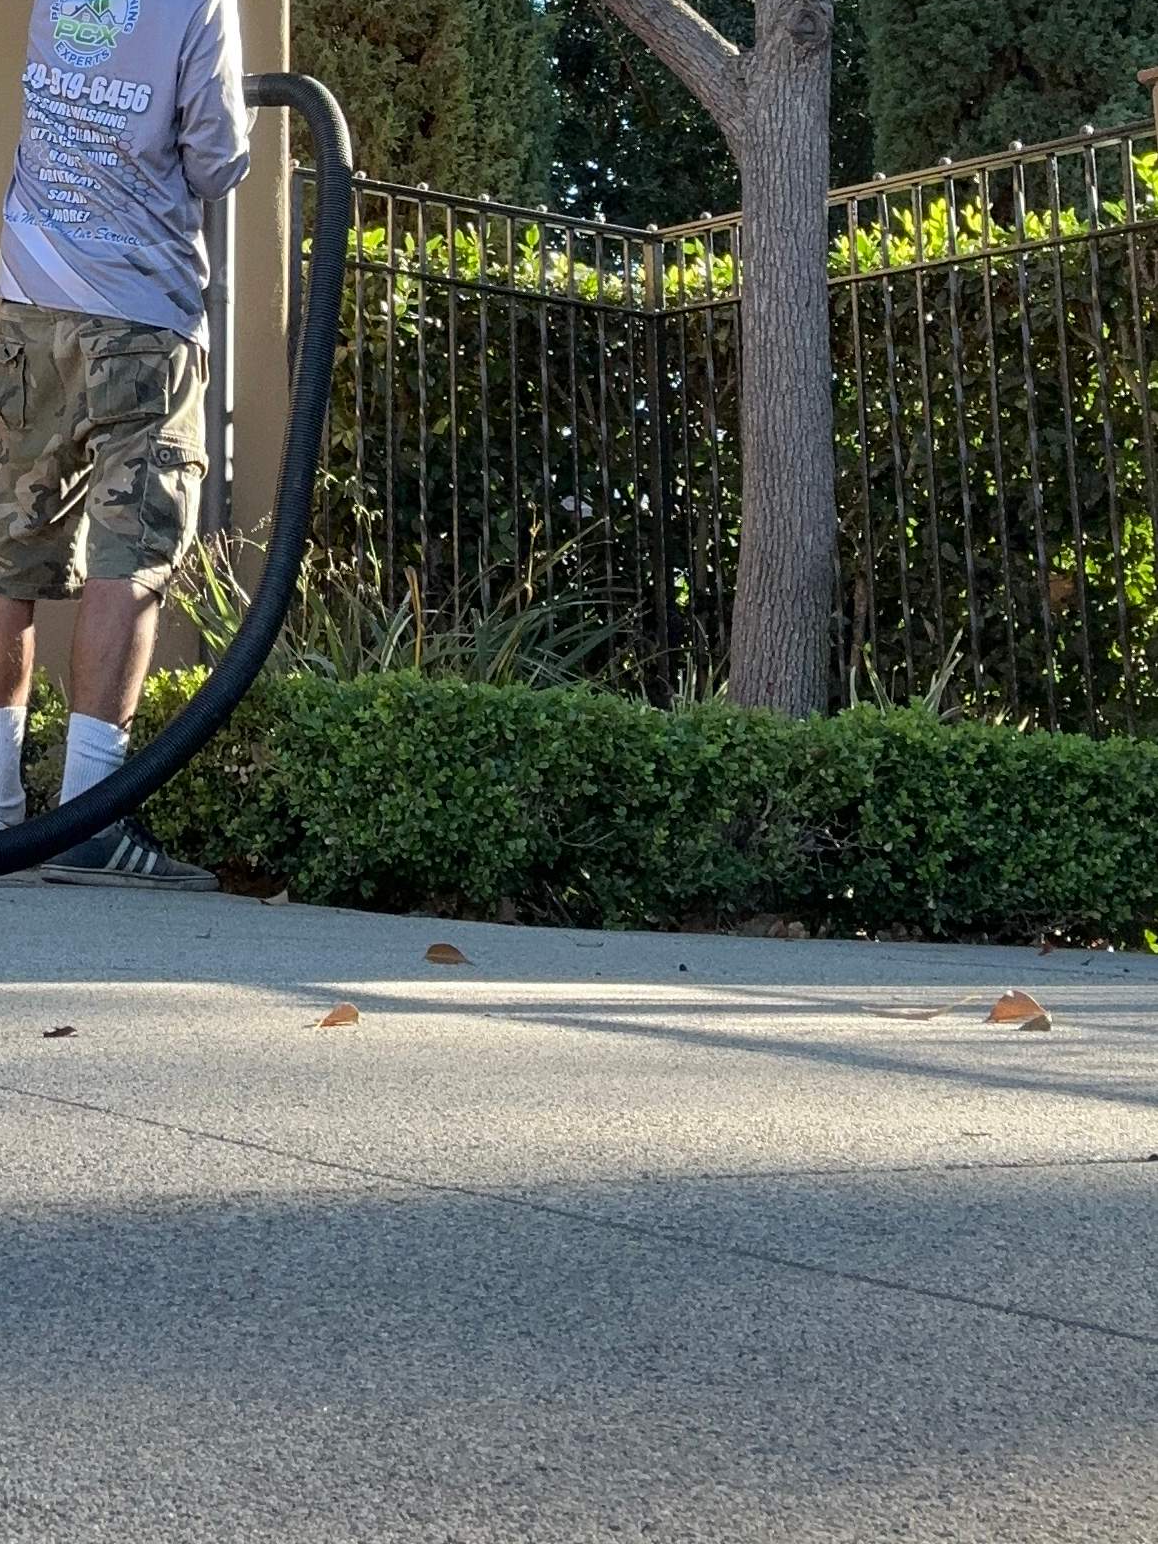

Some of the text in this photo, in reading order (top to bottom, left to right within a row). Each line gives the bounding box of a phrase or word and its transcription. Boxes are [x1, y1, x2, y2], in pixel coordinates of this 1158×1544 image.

[54, 16, 123, 48] PCX
[54, 41, 111, 68] EXPERTS
[94, 227, 146, 246] Service
